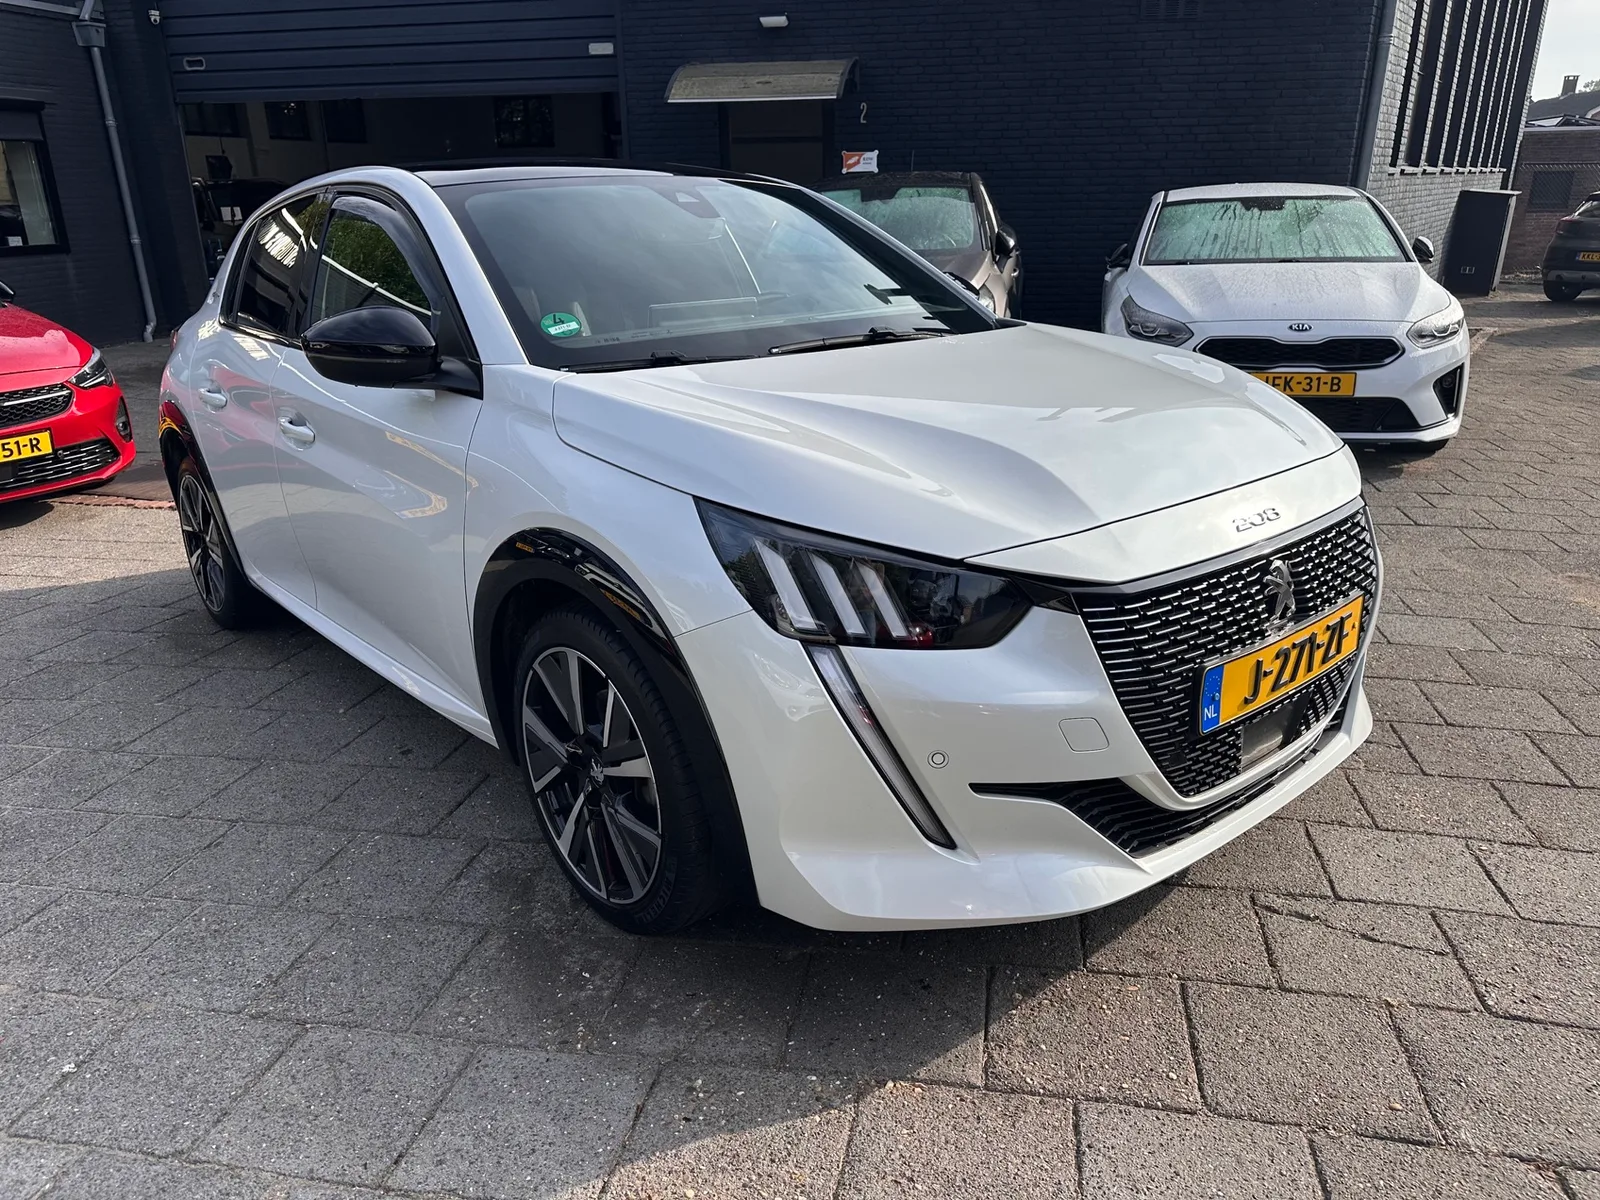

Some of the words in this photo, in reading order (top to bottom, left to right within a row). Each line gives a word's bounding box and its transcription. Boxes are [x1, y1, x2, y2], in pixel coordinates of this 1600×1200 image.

[860, 102, 867, 123] 2
[553, 313, 565, 324] 4
[1291, 323, 1310, 331] KIA
[1, 437, 42, 458] 51-R
[1232, 507, 1281, 533] 208
[1243, 612, 1352, 705] J-271-ZF
[1204, 707, 1217, 721] NL
